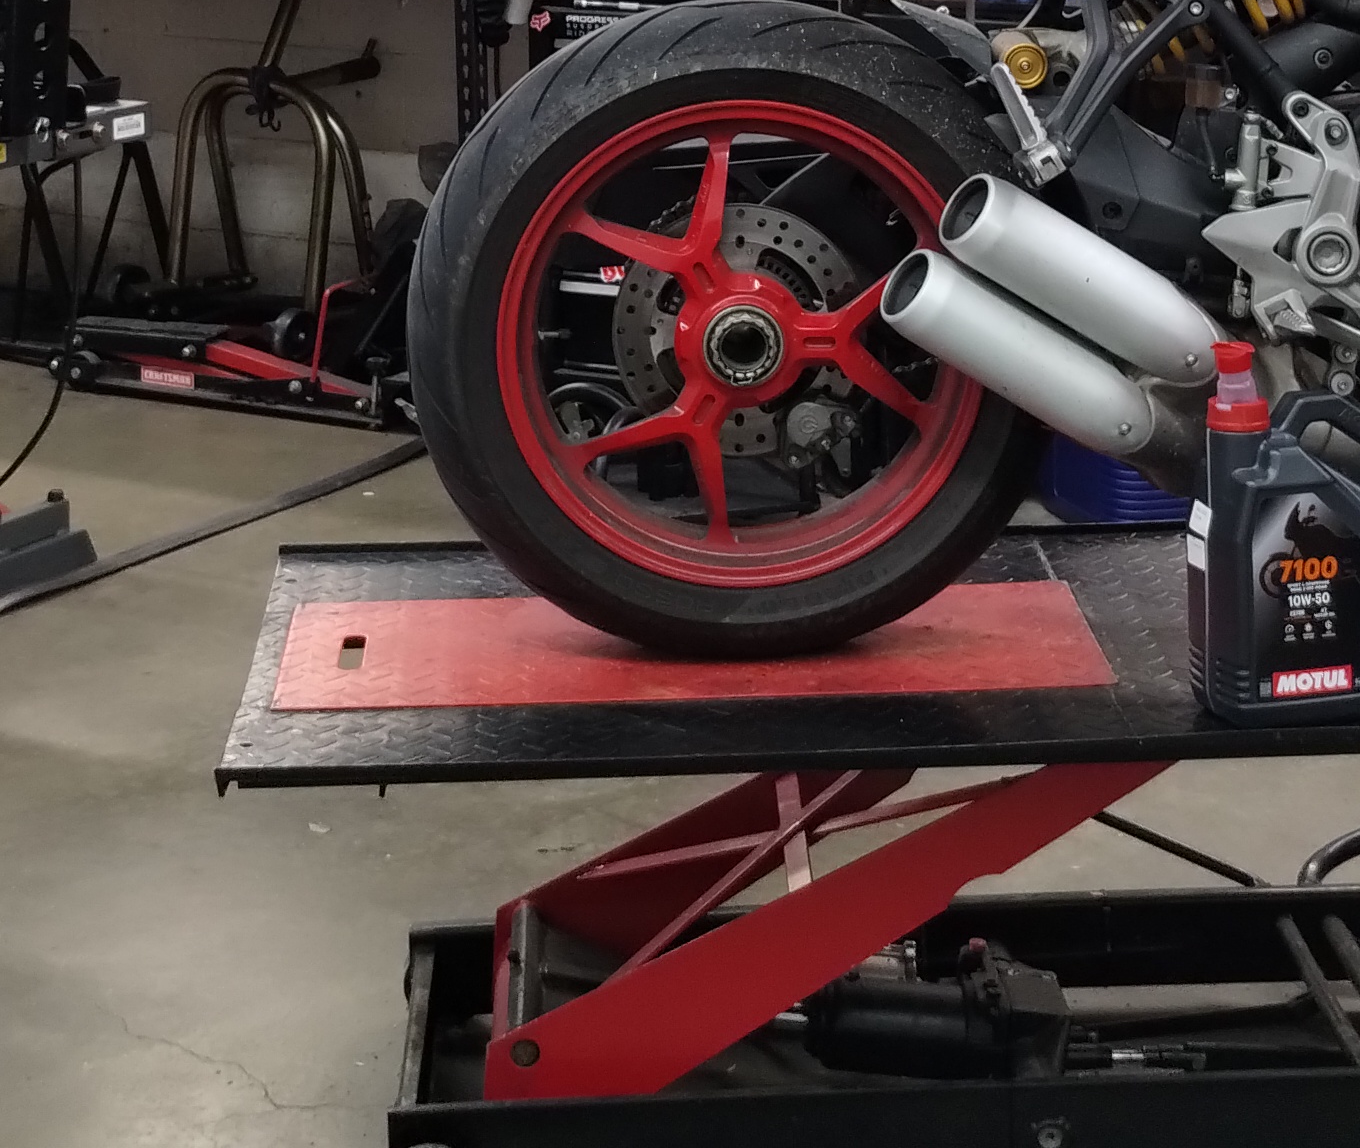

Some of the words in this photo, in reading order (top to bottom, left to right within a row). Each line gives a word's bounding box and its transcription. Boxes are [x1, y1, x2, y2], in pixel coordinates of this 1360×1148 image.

[1280, 555, 1338, 583] 7100
[1288, 592, 1331, 608] 10W-50
[1277, 668, 1348, 693] MOTUL
